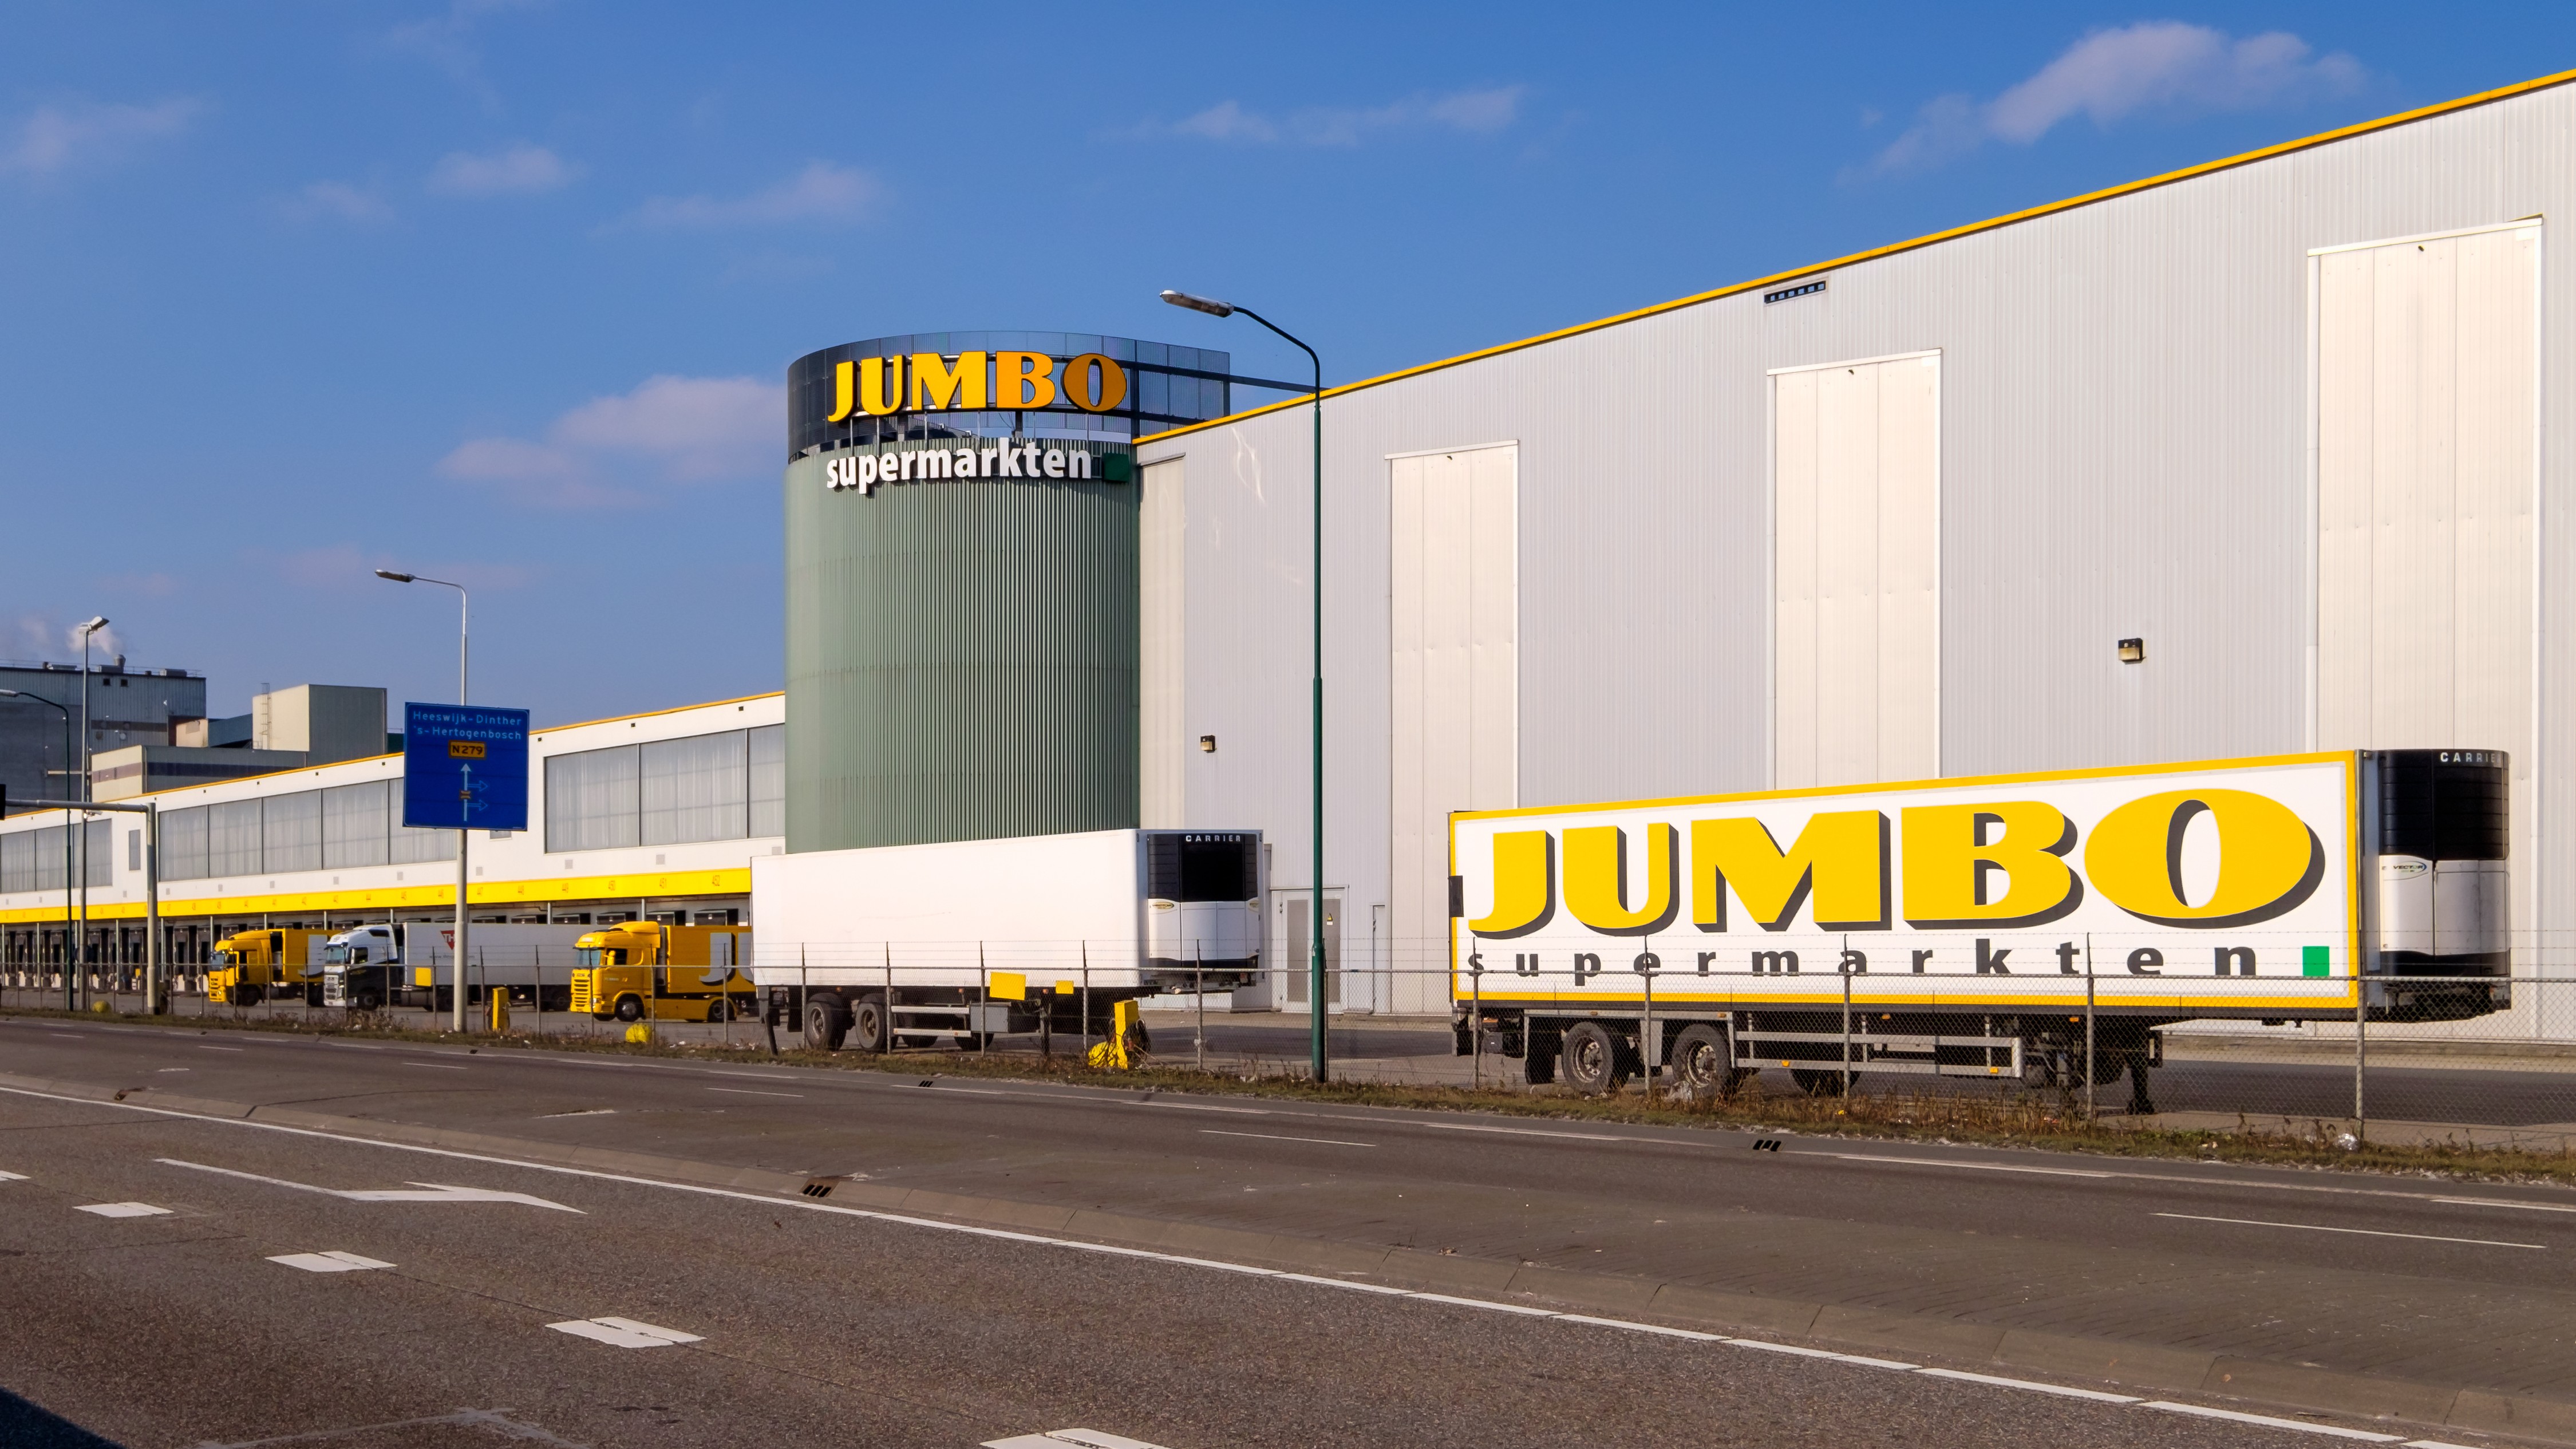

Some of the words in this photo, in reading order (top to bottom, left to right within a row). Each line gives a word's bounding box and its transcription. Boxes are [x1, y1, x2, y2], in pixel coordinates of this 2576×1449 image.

[827, 350, 1127, 422] JUMBO
[827, 437, 1092, 495] supermarkten
[413, 711, 521, 725] Heeswijk-Dinther
[452, 745, 483, 755] N279
[712, 875, 720, 886] 452
[1468, 788, 2326, 939] JUMBO
[1467, 938, 2257, 986] supermarkten
